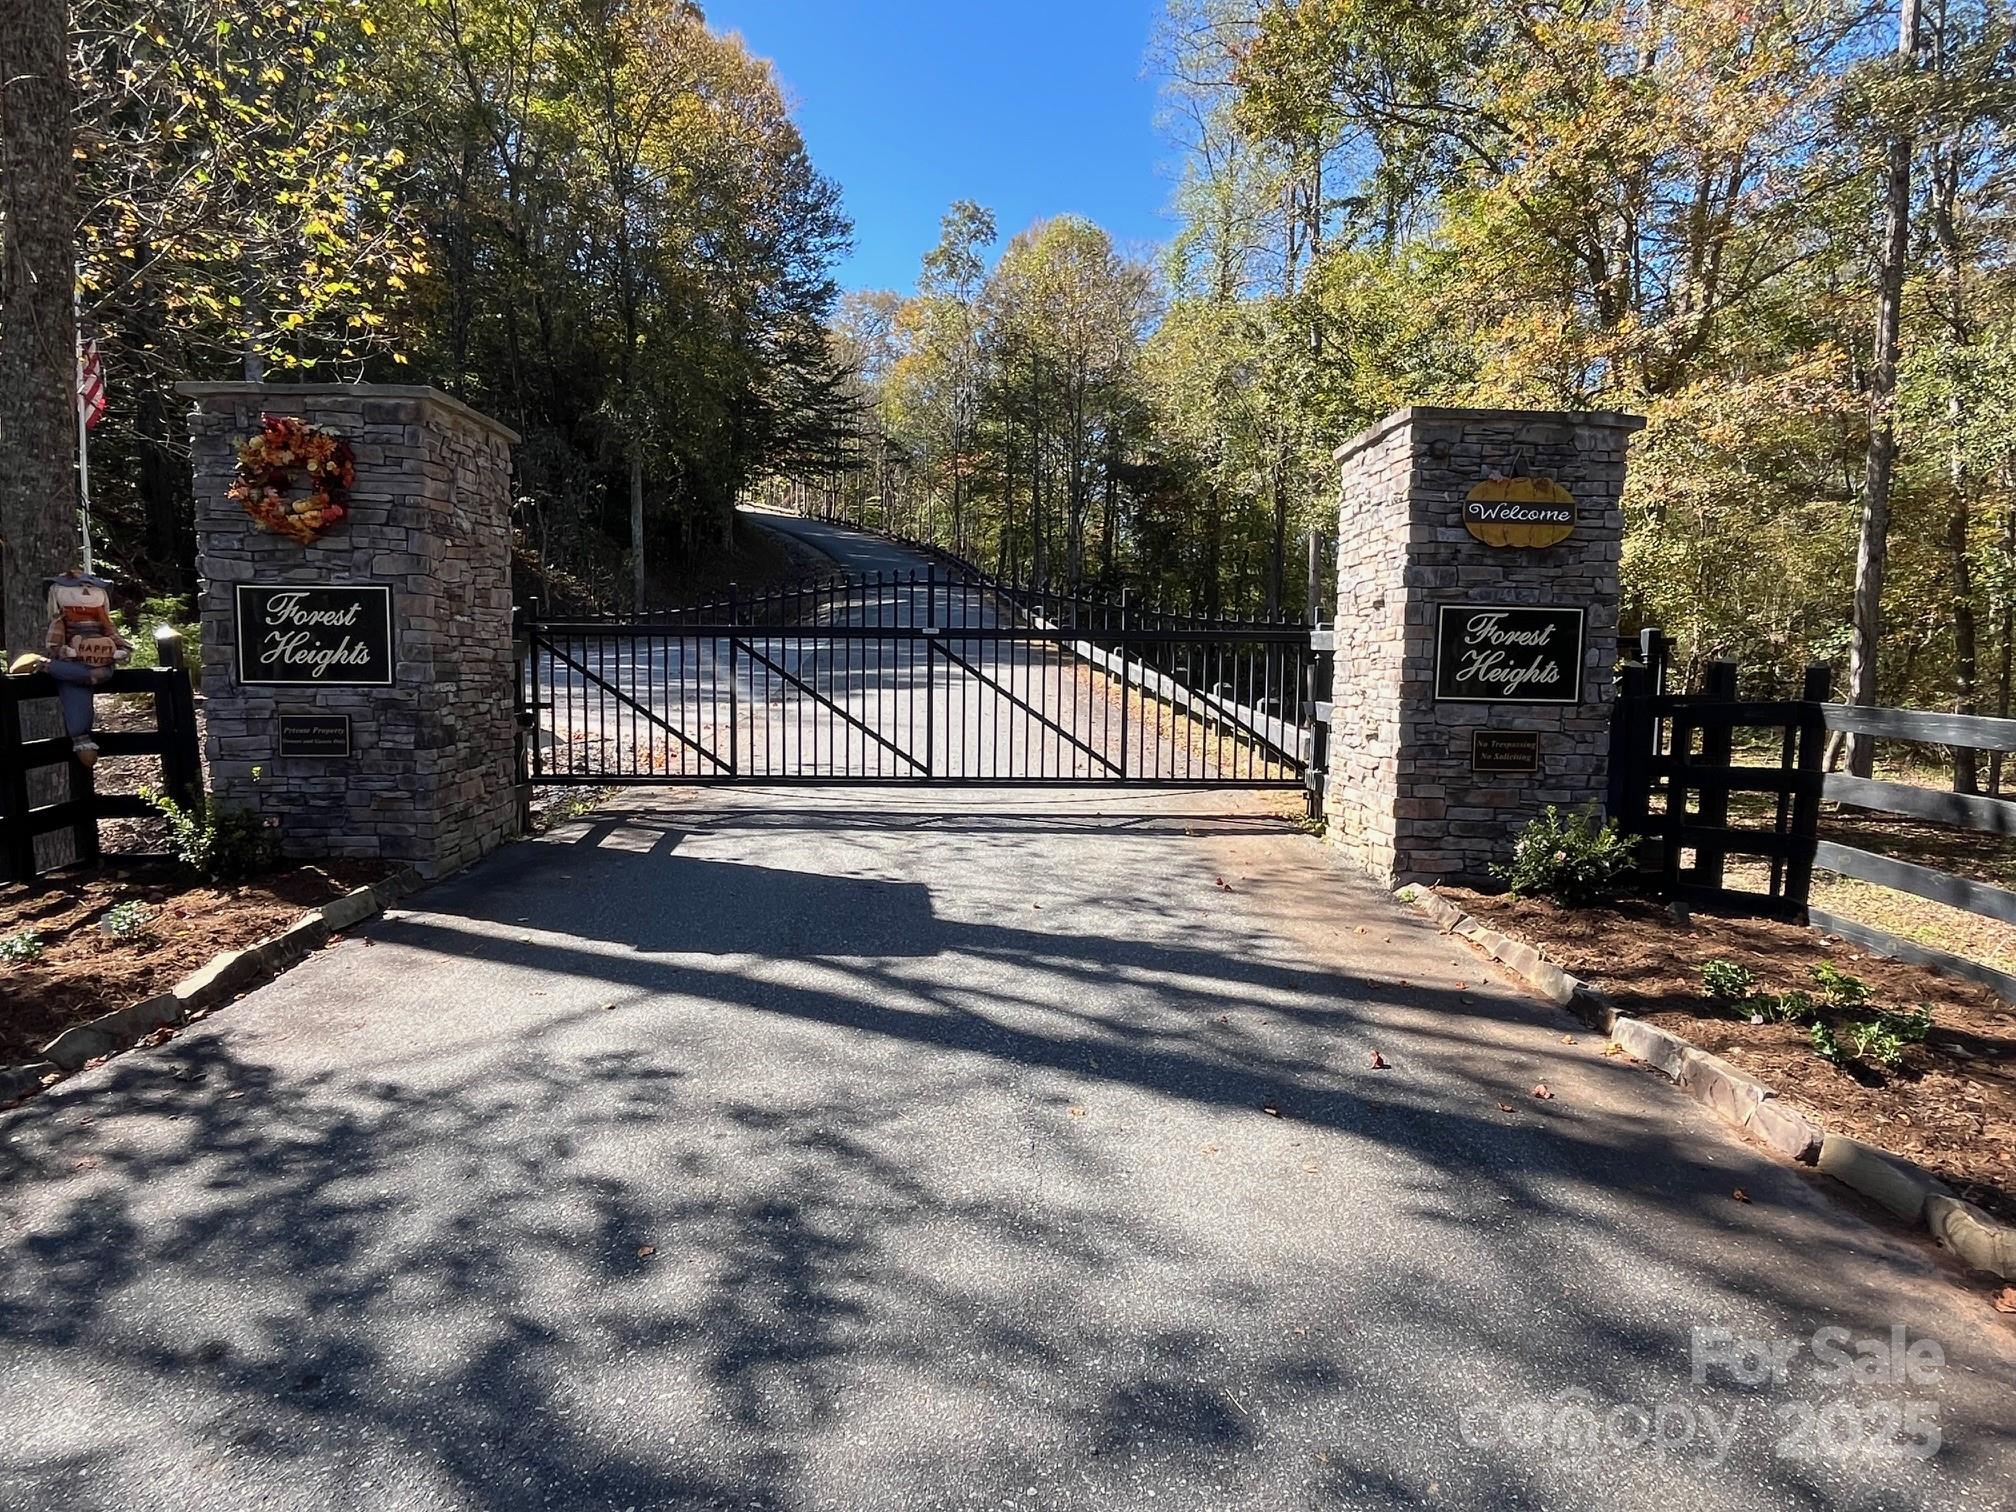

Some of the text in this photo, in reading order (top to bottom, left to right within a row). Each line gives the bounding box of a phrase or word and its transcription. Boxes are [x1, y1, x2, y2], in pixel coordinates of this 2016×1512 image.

[1469, 503, 1571, 520] Welcome
[265, 592, 362, 626] Forest
[1464, 613, 1556, 646] Forest
[260, 631, 370, 678] Heights
[1456, 649, 1560, 695] Heights
